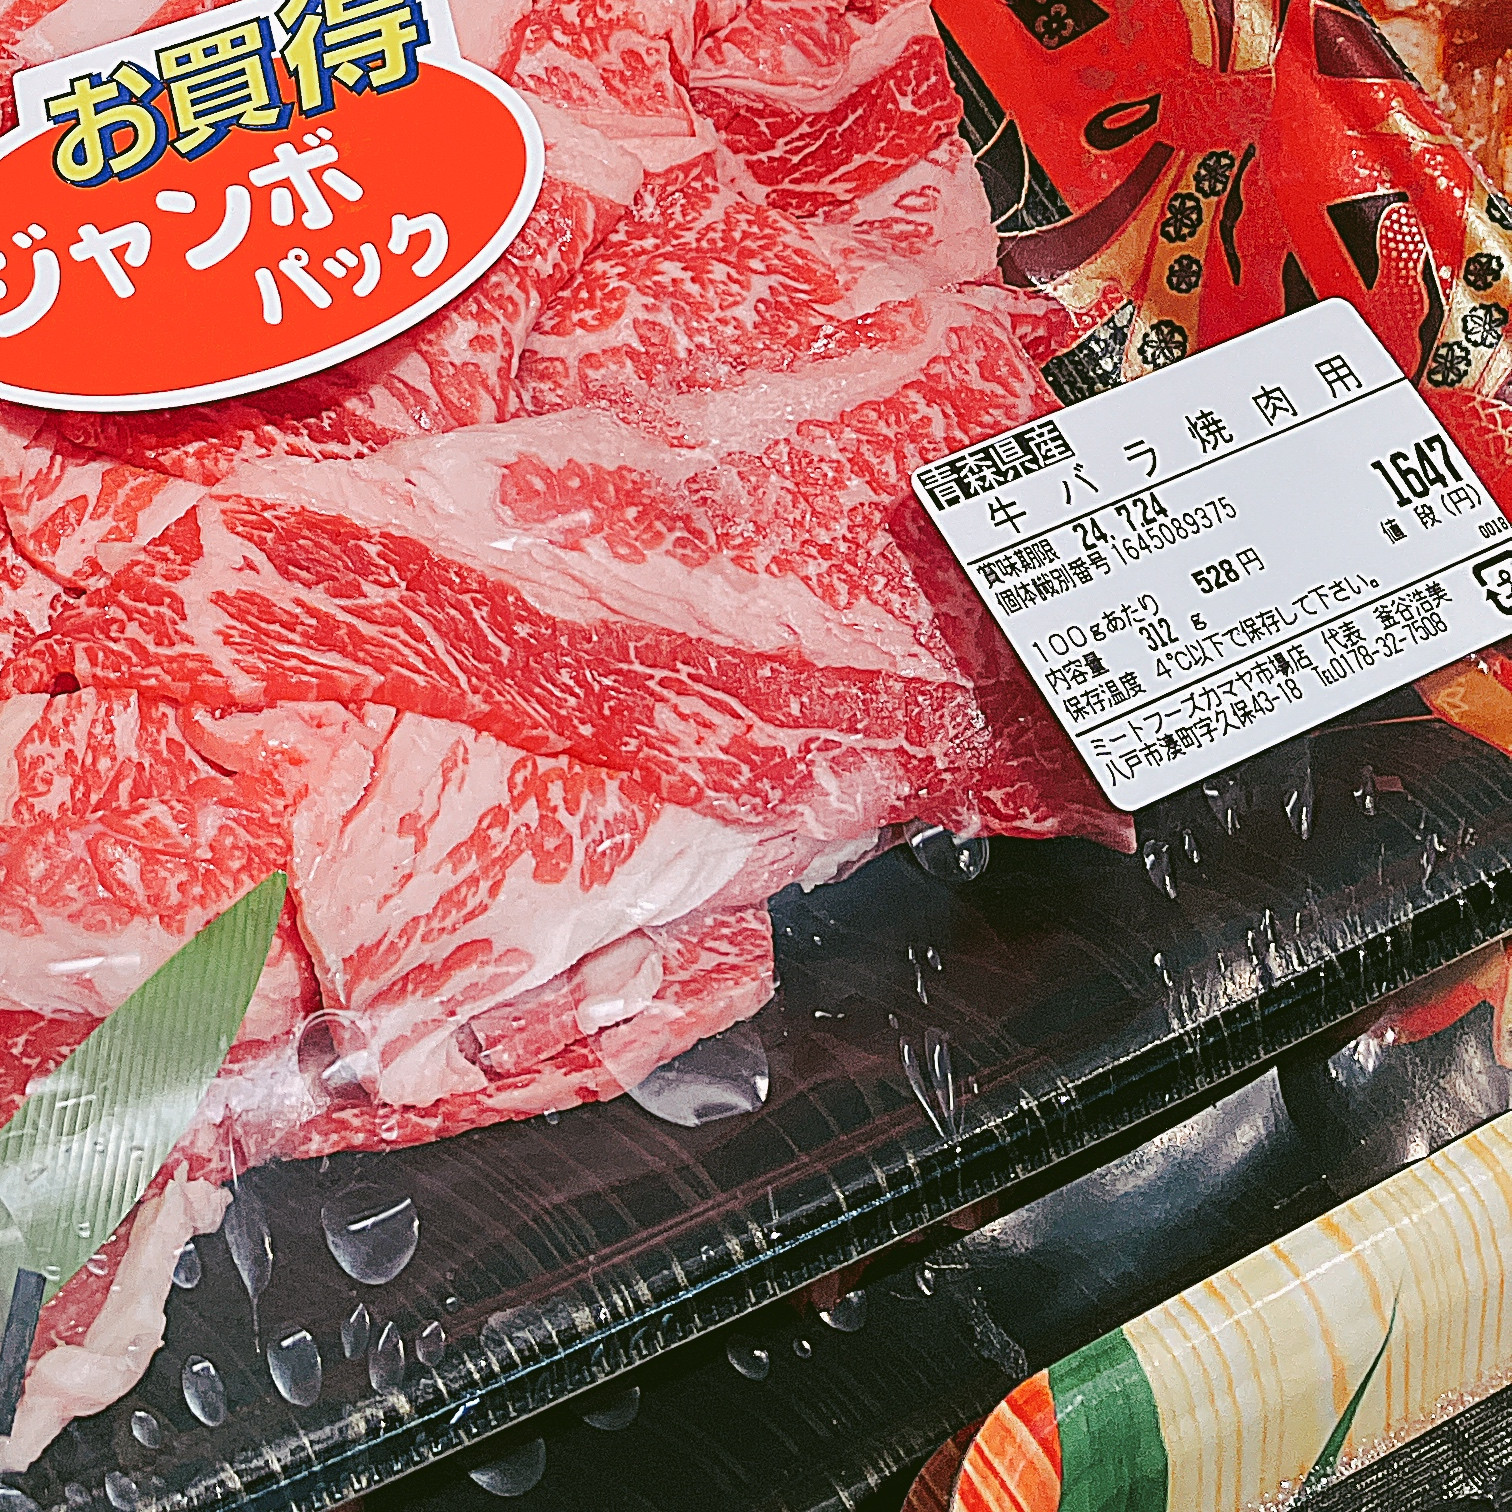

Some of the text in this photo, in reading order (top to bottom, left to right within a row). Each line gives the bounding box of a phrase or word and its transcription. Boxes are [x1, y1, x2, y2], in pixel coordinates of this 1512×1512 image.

[254, 212, 449, 324] パック
[917, 419, 1077, 512] 青森県産
[1371, 434, 1464, 508] 1647
[1111, 496, 1237, 566] 1645089375
[1478, 516, 1509, 539] 0018
[976, 539, 1058, 589] 賞味期限
[1045, 613, 1208, 695] 内容量 312 g
[1321, 620, 1367, 656] 代表
[1062, 671, 1147, 723] 保存温度
